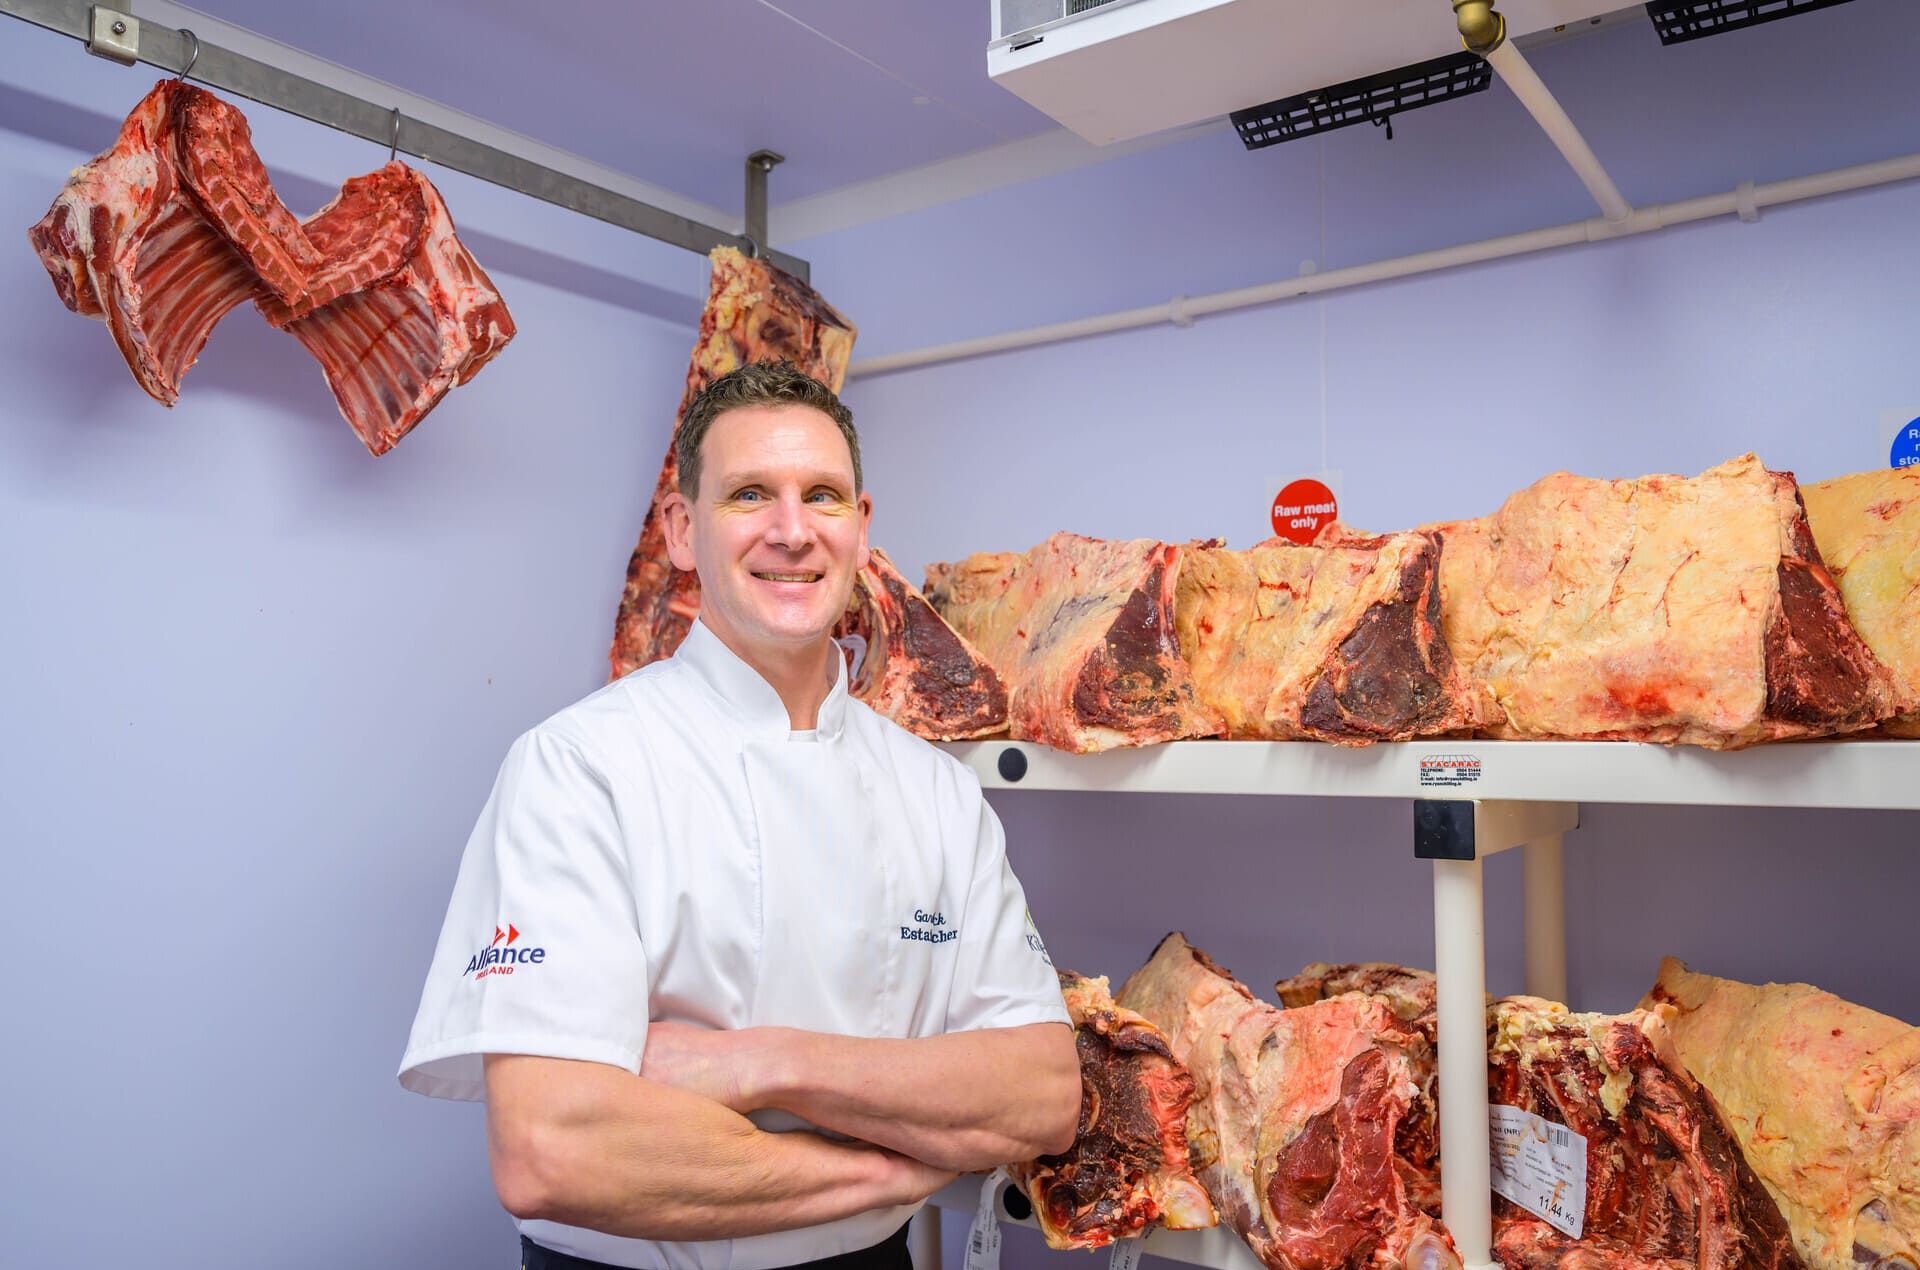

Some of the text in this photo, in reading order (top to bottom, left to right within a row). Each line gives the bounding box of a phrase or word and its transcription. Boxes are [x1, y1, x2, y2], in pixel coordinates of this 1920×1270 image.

[1274, 502, 1335, 518] Raw meat
[1291, 515, 1318, 531] only
[1539, 1195, 1562, 1218] 11.44
[1565, 1211, 1575, 1227] Kg
